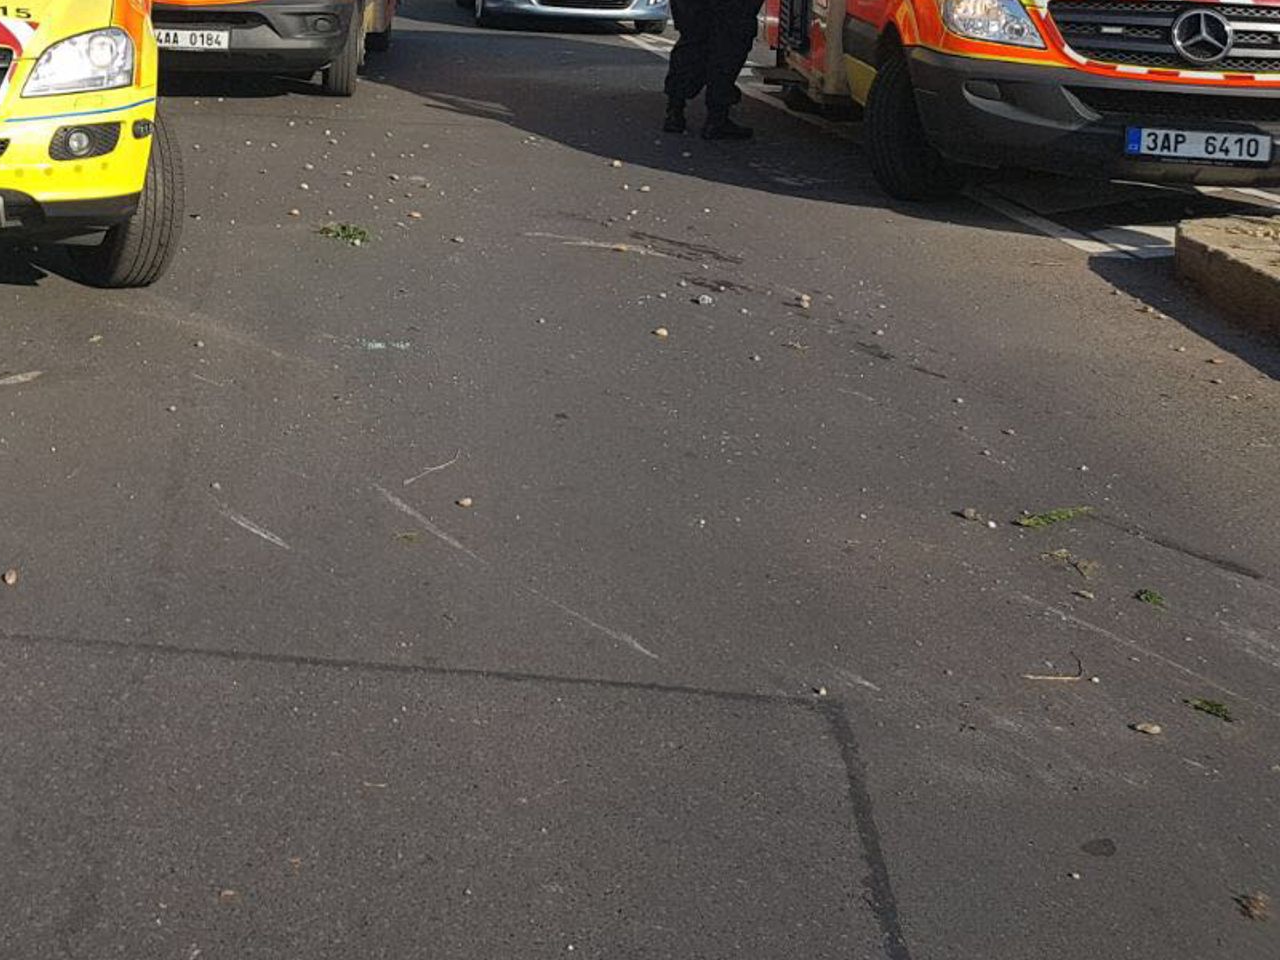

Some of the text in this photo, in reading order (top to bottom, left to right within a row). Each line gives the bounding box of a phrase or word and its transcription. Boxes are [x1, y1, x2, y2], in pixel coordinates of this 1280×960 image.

[154, 31, 222, 46] 4AA 0184
[1146, 131, 1260, 158] 3AP 6410
